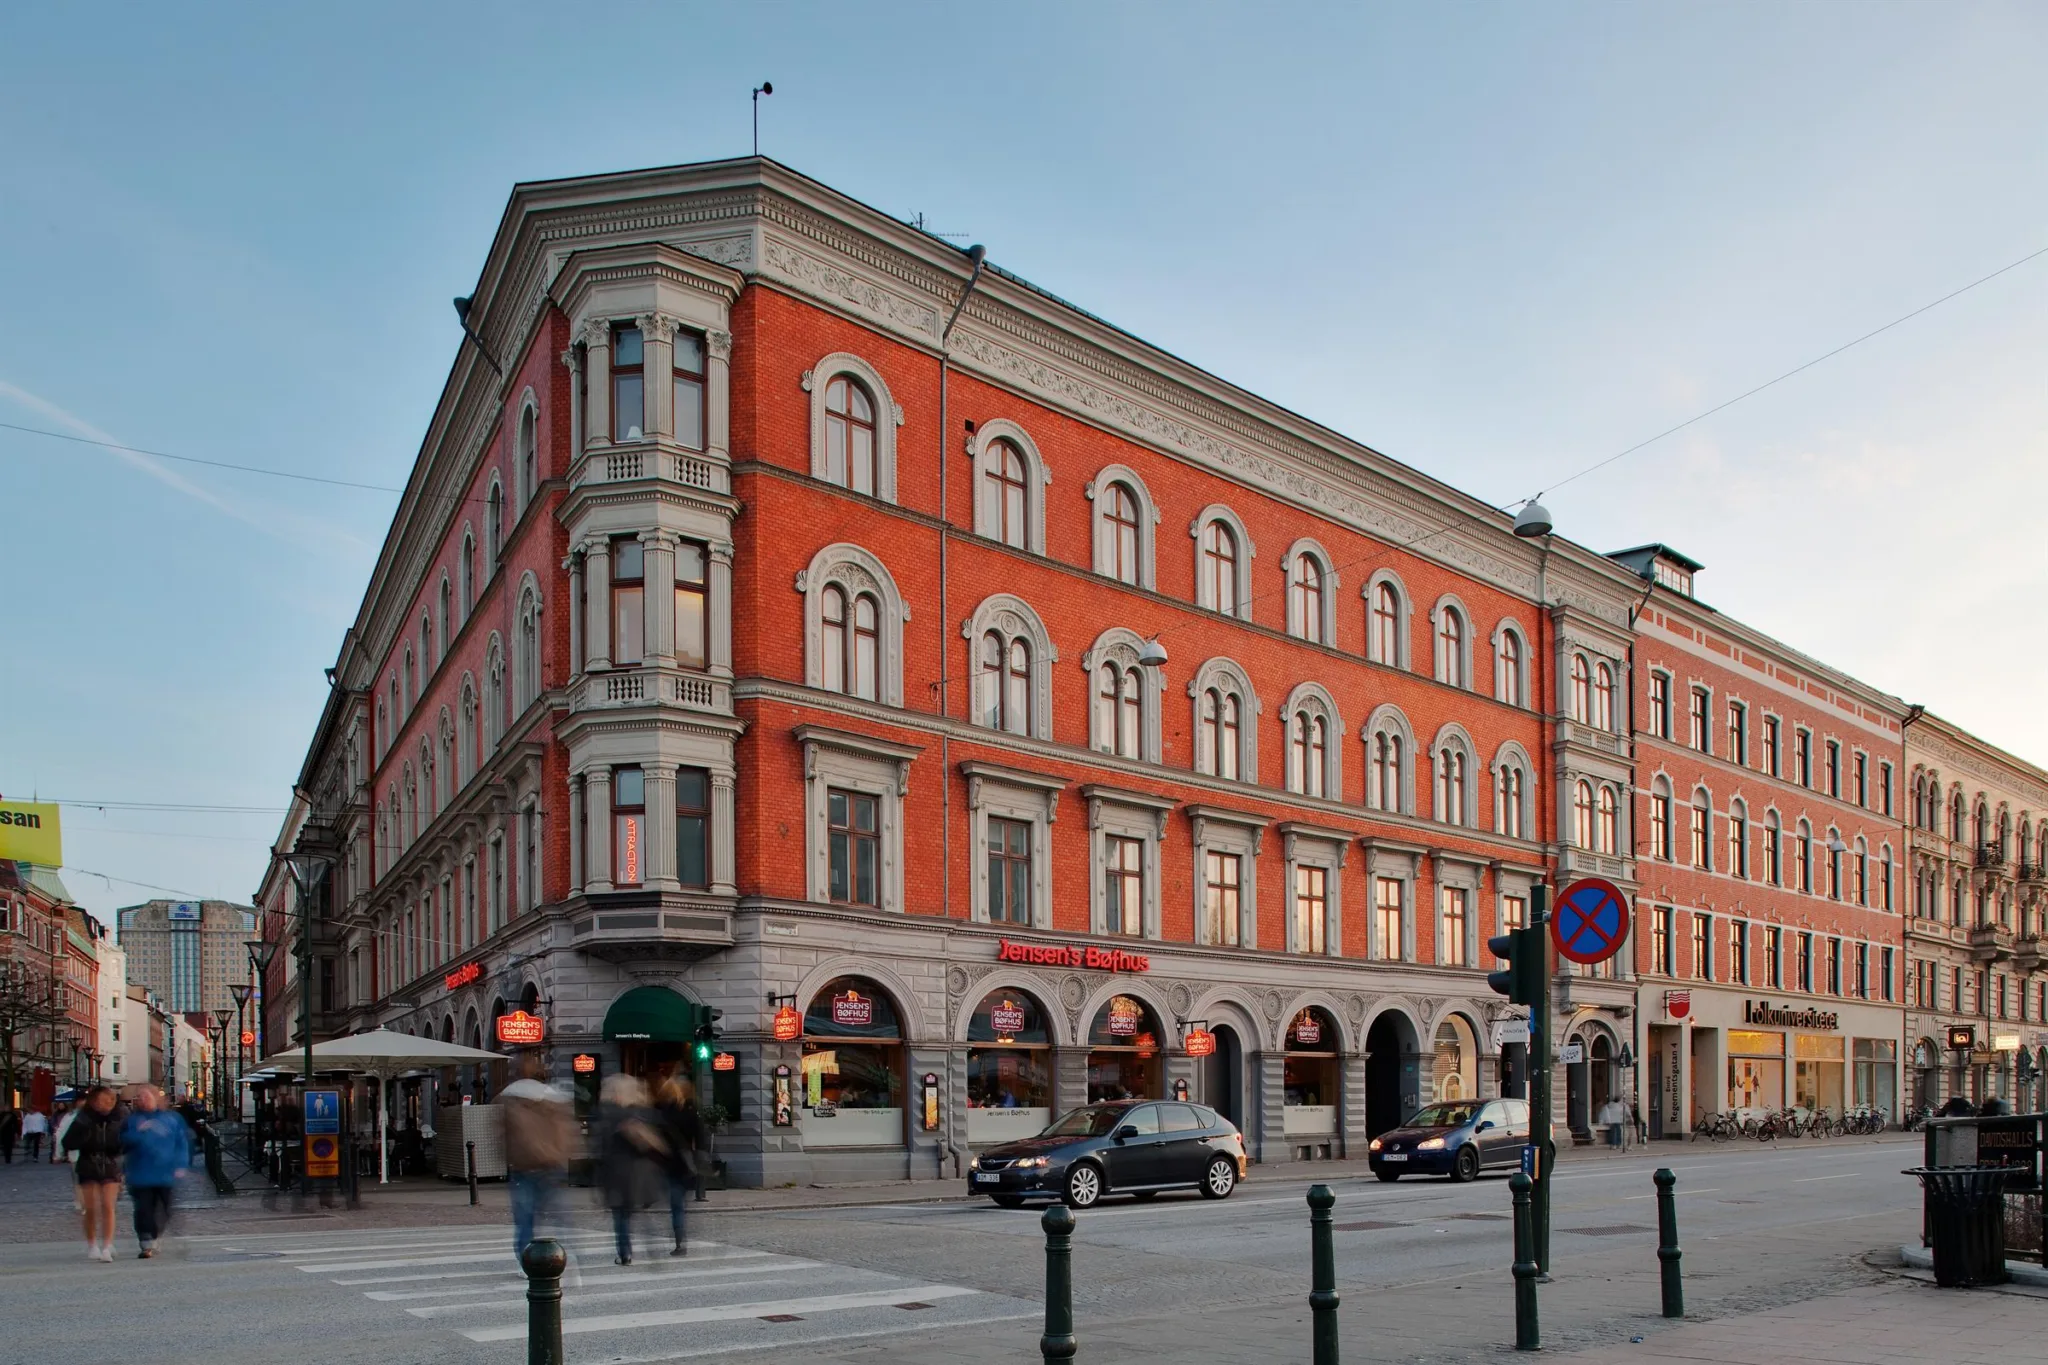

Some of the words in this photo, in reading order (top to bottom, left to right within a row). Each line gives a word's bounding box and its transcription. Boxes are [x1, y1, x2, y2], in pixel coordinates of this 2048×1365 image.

[627, 818, 636, 881] ATTRACTION
[998, 938, 1083, 966] Jensen's
[1085, 946, 1150, 974] Bøfhus
[835, 1001, 870, 1011] JENSEN'S
[837, 1009, 869, 1018] BØFHUS
[993, 1010, 1023, 1019] JENSEN'S
[501, 1020, 541, 1029] JENSEN'S
[994, 1017, 1022, 1026] BØFHUS
[503, 1028, 539, 1036] BØFHUS
[1670, 1050, 1679, 1123] Regementsgatan
[1980, 1131, 2033, 1148] DAVIDSHALLS
